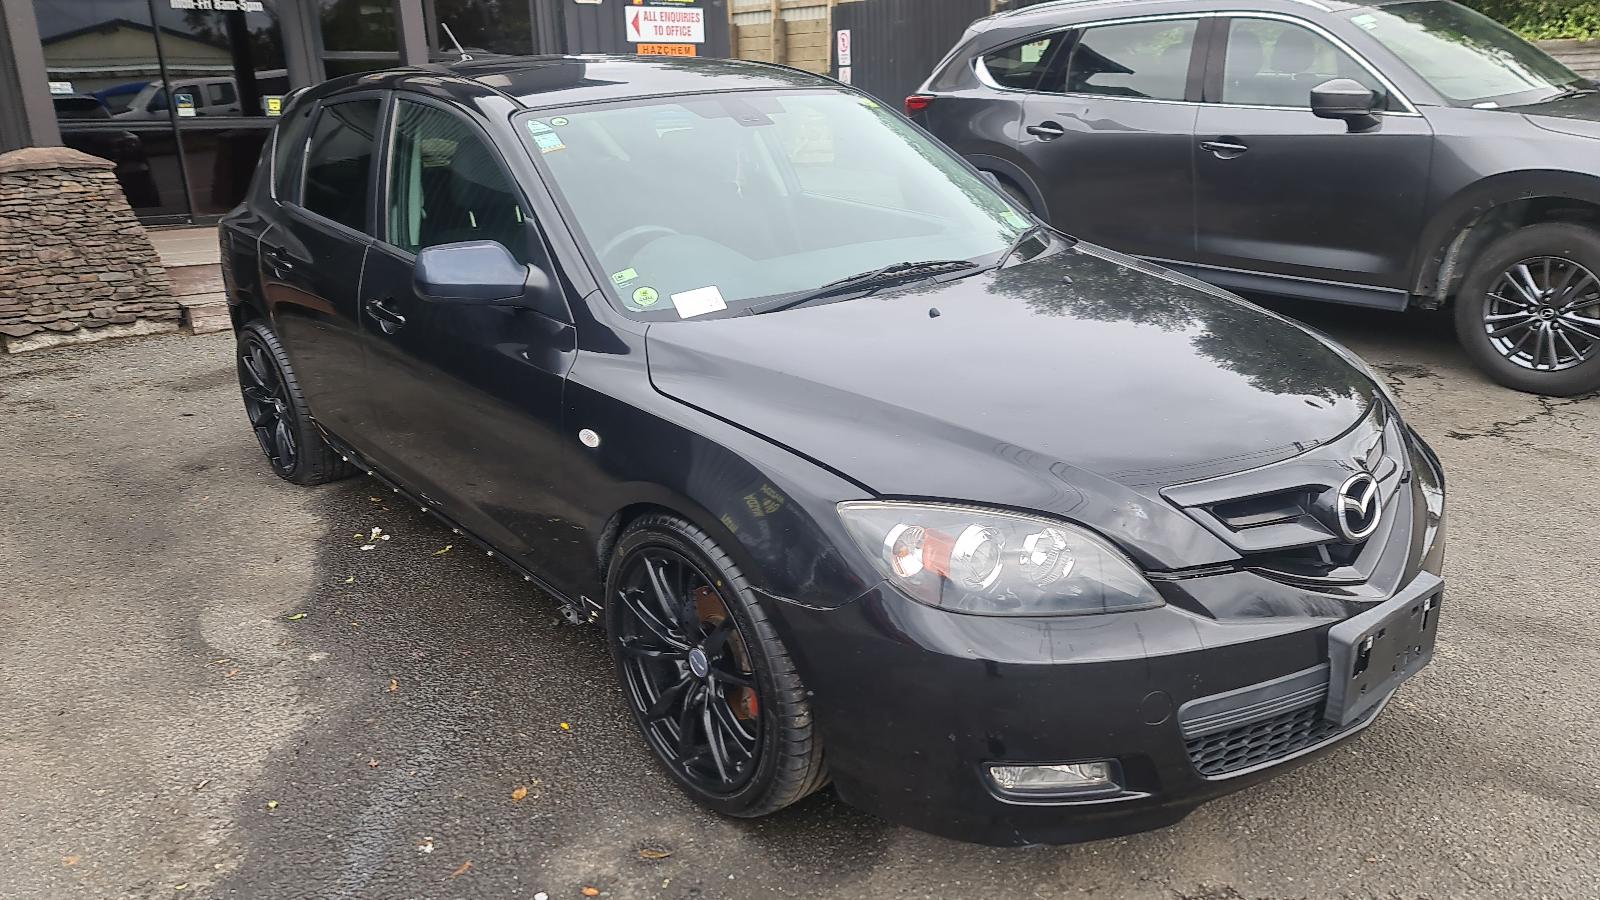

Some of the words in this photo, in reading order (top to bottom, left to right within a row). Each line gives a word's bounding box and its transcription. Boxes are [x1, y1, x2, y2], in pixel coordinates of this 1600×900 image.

[643, 11, 657, 21] ALL
[660, 12, 700, 22] ENQUIRIES
[654, 25, 664, 35] TO
[666, 26, 691, 36] OFFICE
[643, 45, 691, 54] HAZCHEM
